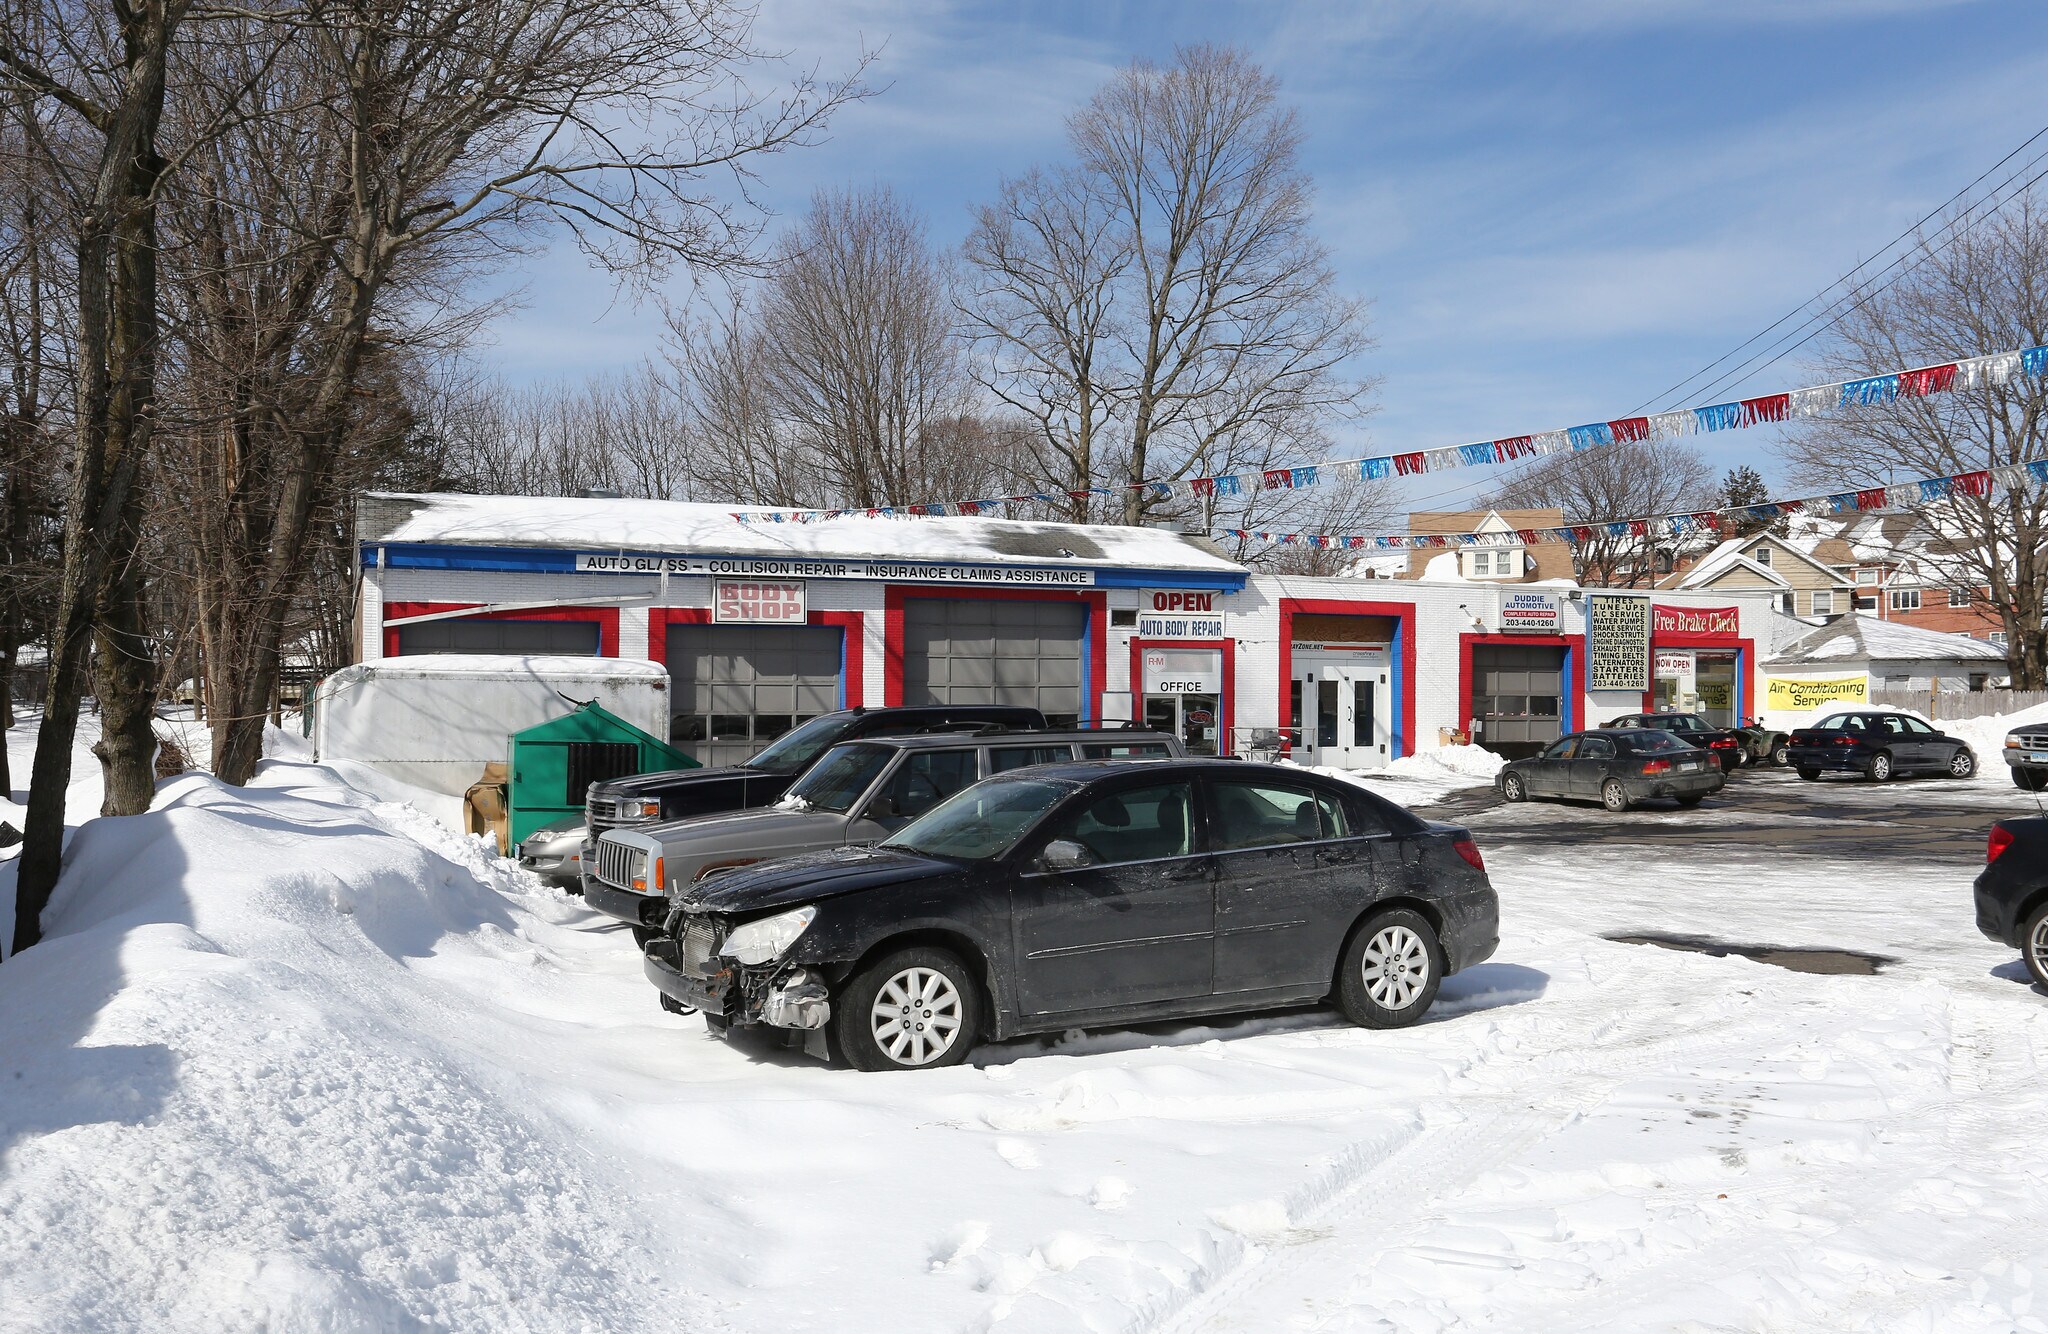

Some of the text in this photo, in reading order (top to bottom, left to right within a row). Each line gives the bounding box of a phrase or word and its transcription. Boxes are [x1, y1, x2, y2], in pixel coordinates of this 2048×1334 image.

[587, 557, 630, 569] AUTO
[635, 558, 688, 571] GLASS
[709, 560, 789, 574] COLLISION
[794, 563, 846, 576] REPAIR
[866, 565, 946, 579] INSURANCE
[951, 568, 1001, 581] CLAIMS
[1005, 570, 1087, 583] ASSISTANCE
[720, 583, 800, 601] BODY
[1153, 592, 1211, 611] OPEN
[720, 602, 800, 619] SHOP
[1140, 620, 1221, 636] AUTO BODY REPAIR
[1653, 610, 1737, 632] Free Brake Check
[1656, 659, 1690, 668] NOW OPEN
[1160, 682, 1201, 692] OFFICE
[1769, 682, 1864, 695] Air Conditioning
